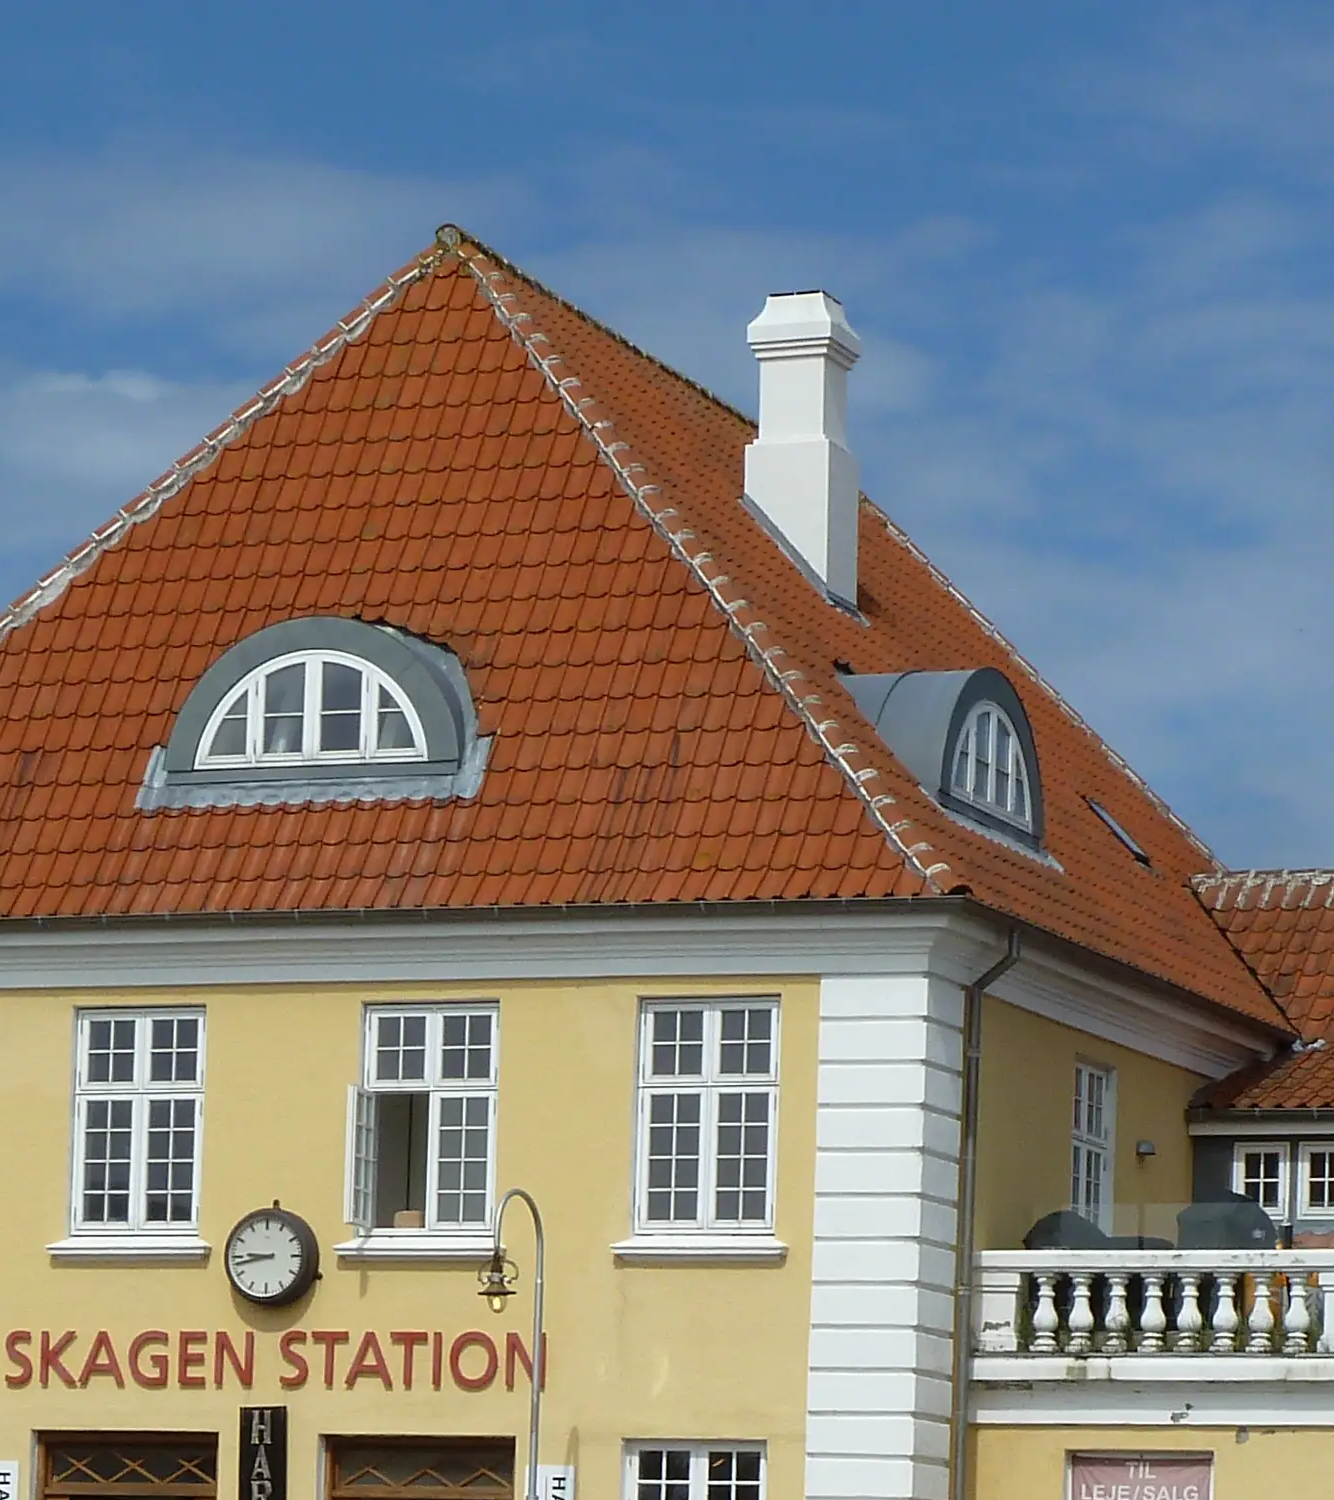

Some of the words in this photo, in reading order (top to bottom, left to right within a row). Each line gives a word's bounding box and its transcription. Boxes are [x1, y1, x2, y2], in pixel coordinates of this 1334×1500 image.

[5, 1330, 255, 1389] SKAGEN
[279, 1331, 547, 1391] STATION
[1126, 1462, 1156, 1479] TIL
